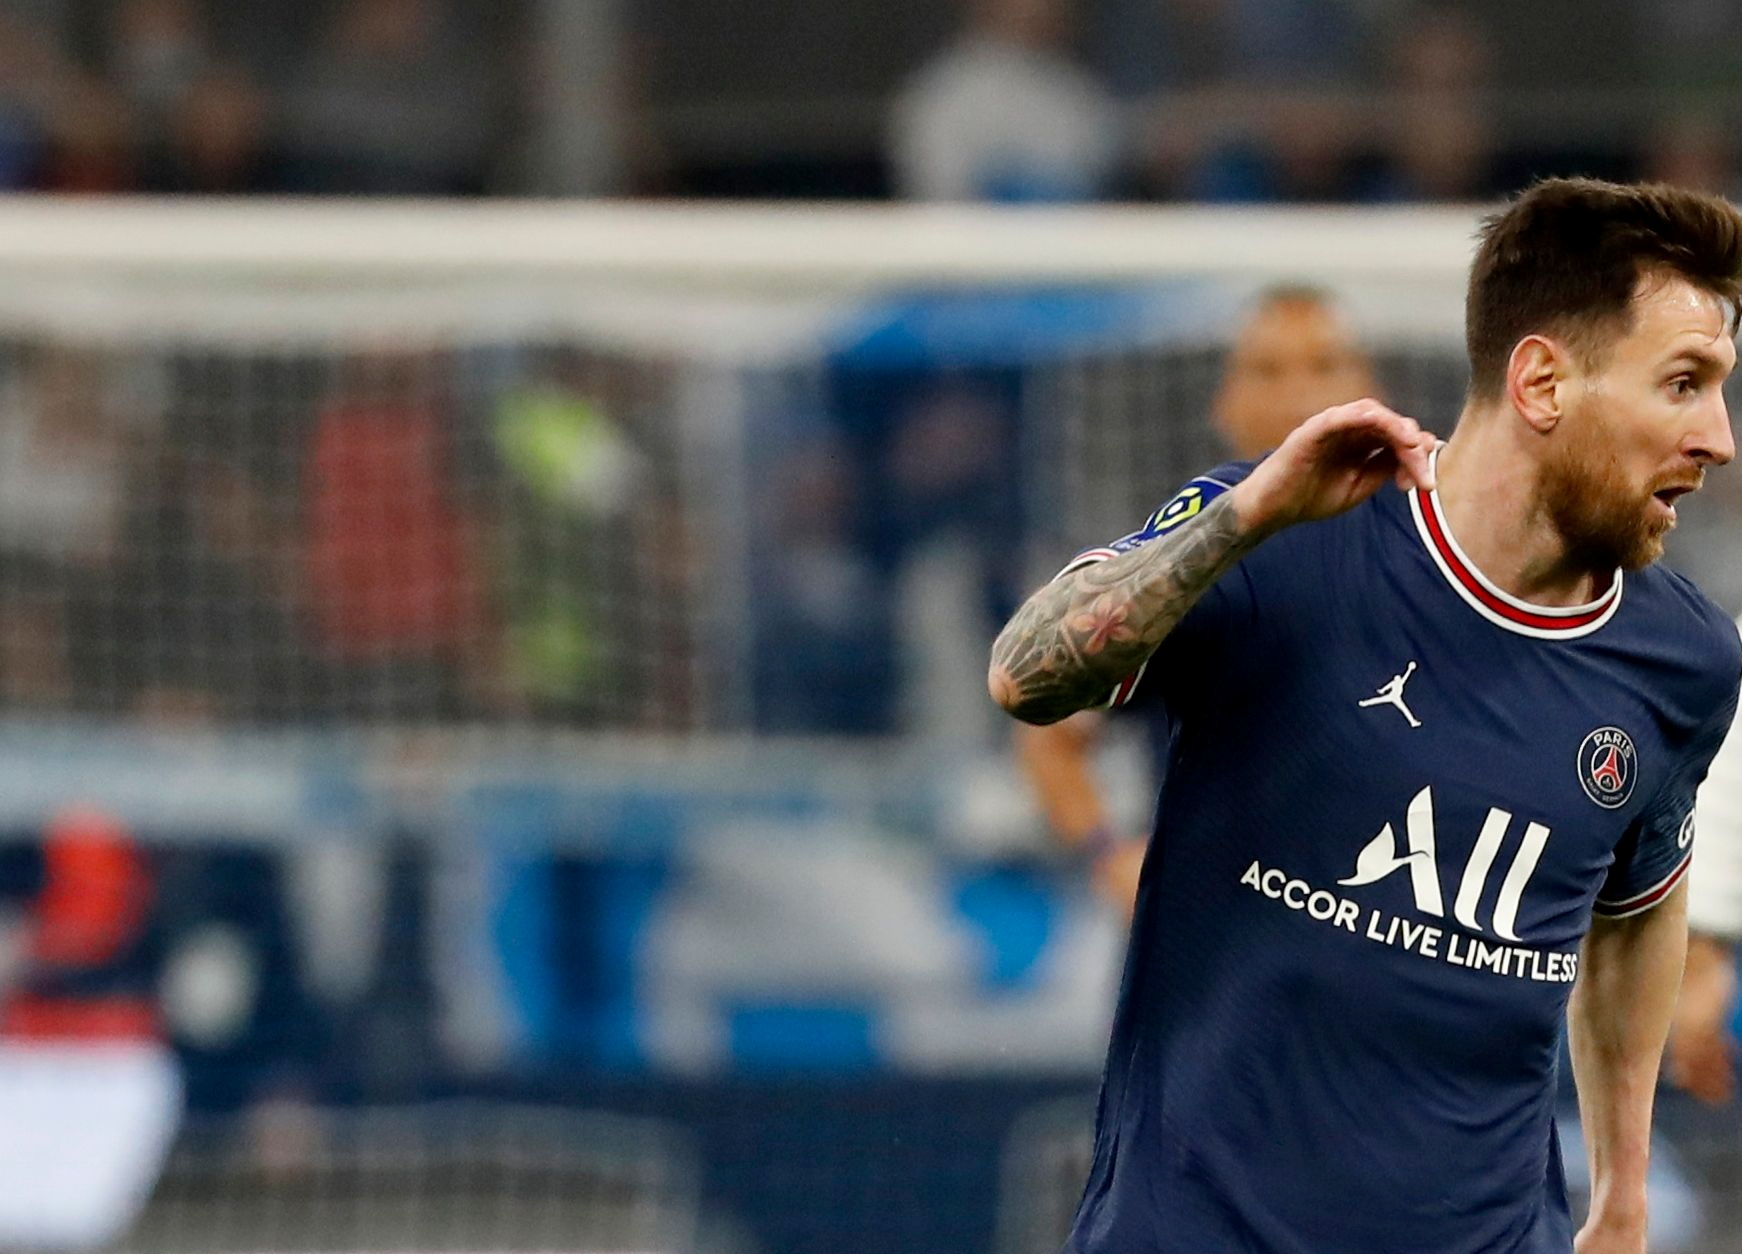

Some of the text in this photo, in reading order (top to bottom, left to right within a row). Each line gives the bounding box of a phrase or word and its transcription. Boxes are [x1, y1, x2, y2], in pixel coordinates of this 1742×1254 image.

[1593, 731, 1633, 758] PARIS
[1240, 860, 1579, 982] ACCOR LIVE LIMITLESS
